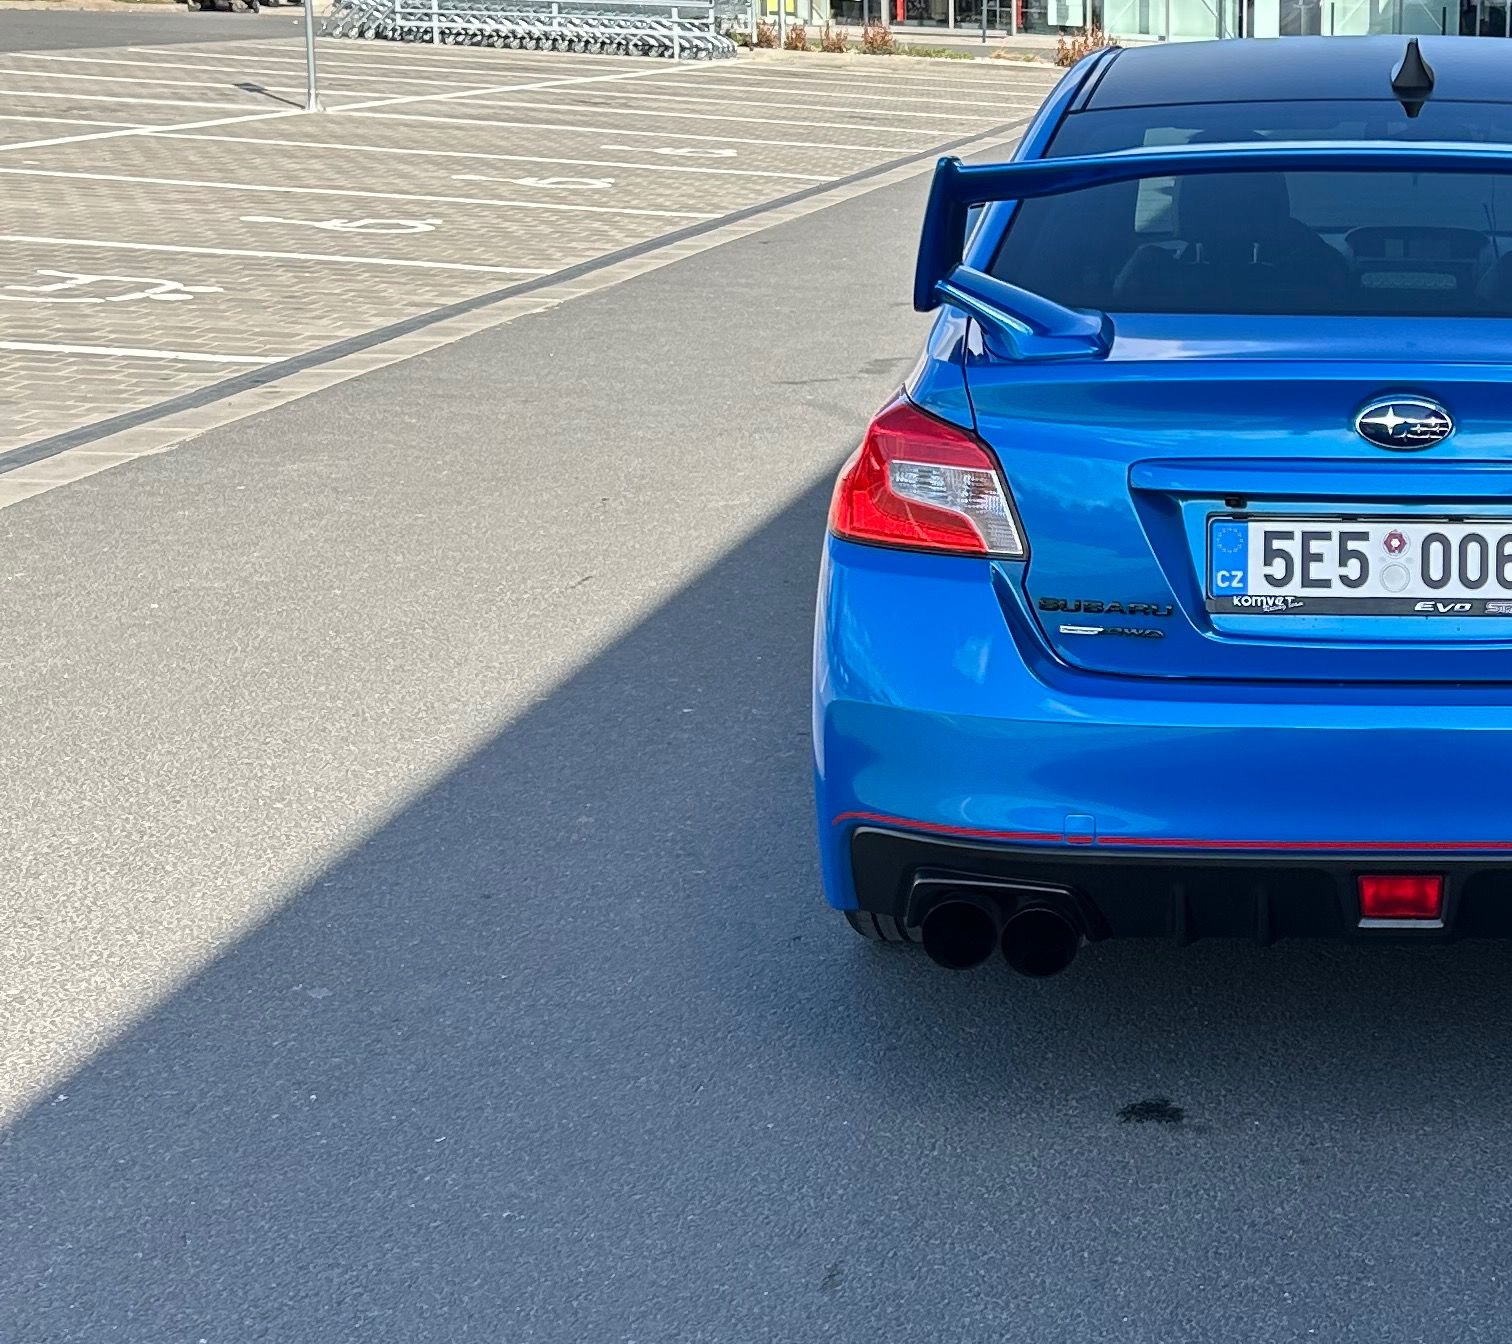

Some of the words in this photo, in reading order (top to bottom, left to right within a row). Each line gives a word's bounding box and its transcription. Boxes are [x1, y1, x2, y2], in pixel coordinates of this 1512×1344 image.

[1263, 530, 1370, 589] 5E5
[1216, 570, 1244, 588] CZ
[1038, 597, 1174, 617] SUBARU
